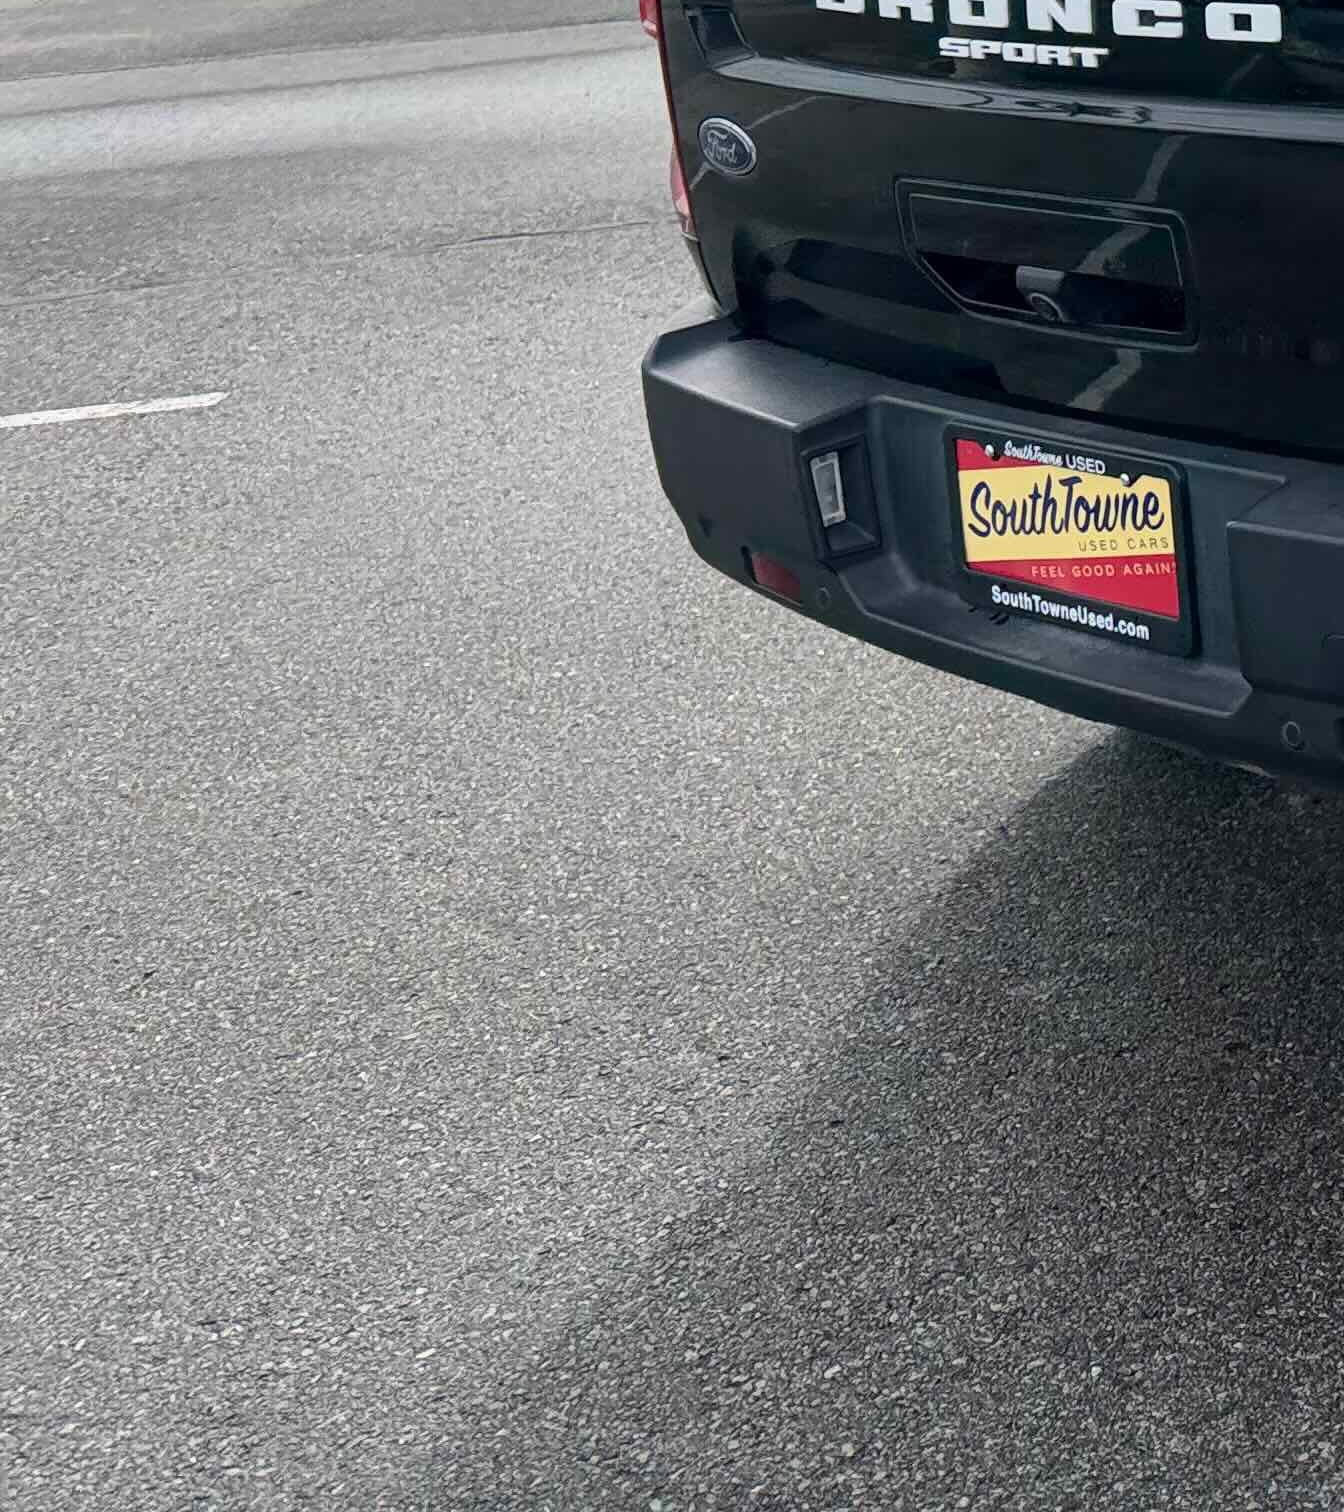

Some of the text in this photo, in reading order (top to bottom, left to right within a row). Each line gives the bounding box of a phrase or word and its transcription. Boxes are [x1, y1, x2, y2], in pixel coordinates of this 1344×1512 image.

[937, 36, 1109, 68] SPORT
[1004, 439, 1106, 475] SouthTowne USED
[967, 472, 1165, 539] SouthTowne
[1078, 537, 1169, 552] USED CARS
[1031, 565, 1066, 578] FEEL
[1071, 563, 1115, 578] GOOD
[991, 585, 1150, 641] SouthTowneUsed.com
